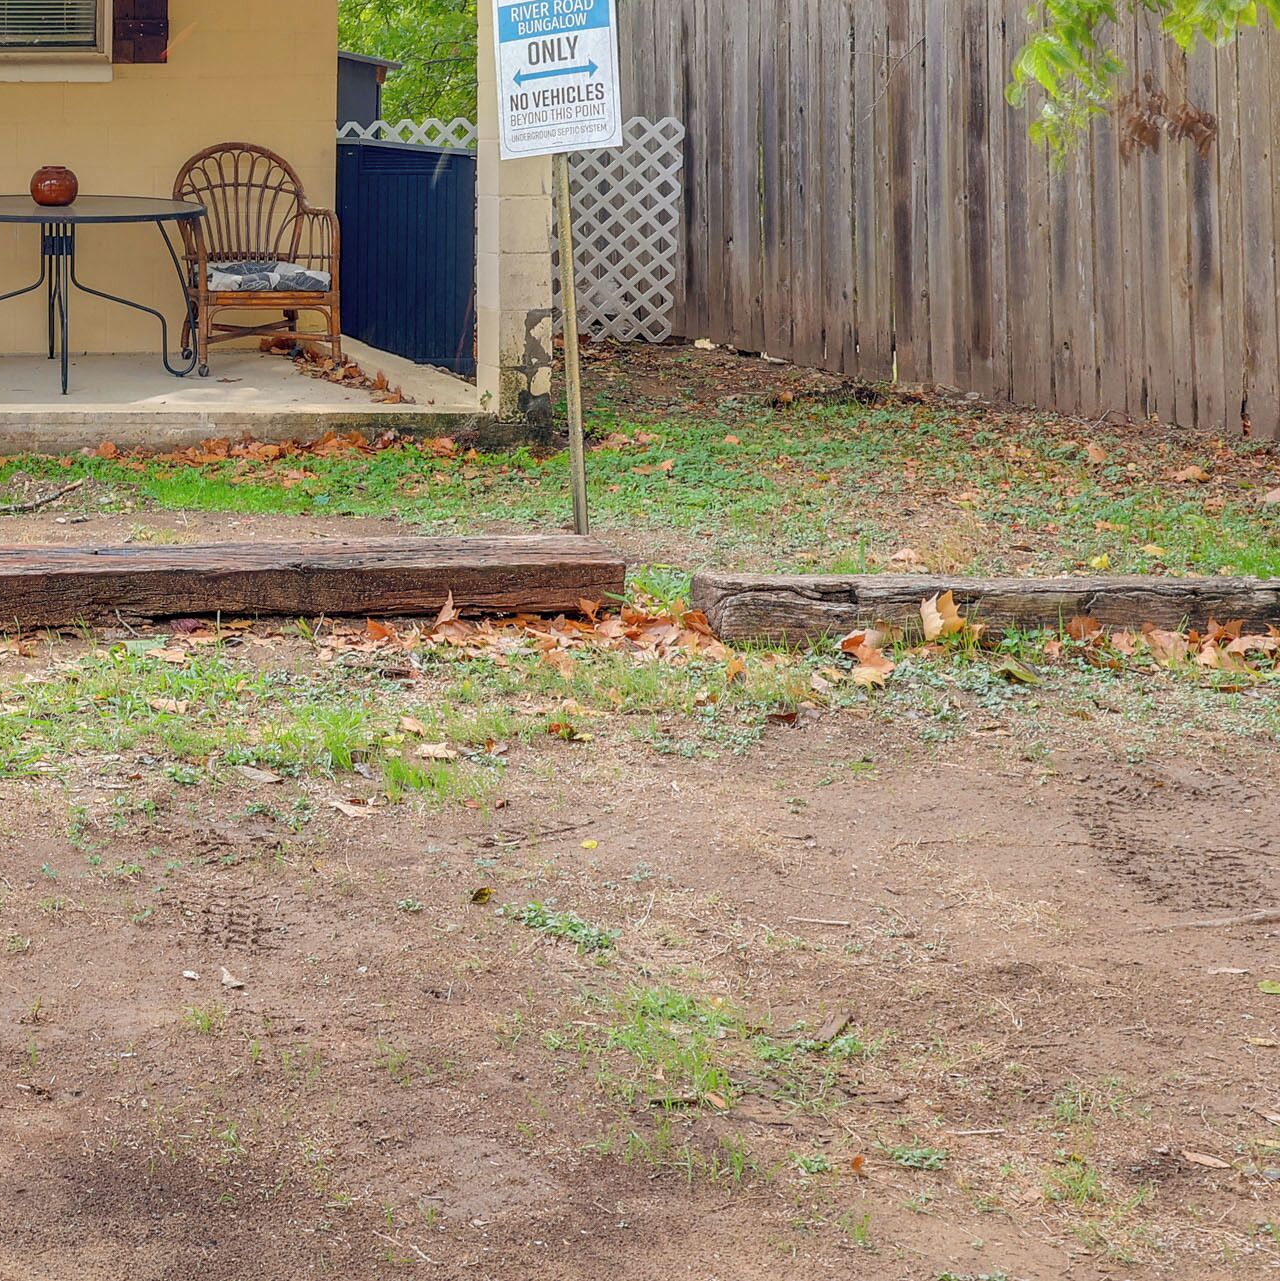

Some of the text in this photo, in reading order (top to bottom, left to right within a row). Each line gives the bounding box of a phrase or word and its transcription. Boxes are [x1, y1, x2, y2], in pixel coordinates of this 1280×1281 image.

[511, 2, 549, 22] RIVER
[519, 13, 587, 35] BUNGALOW
[528, 35, 578, 65] ONLY
[510, 83, 604, 112] NO VEHICLES
[511, 103, 606, 127] BEYOND THIS POINT
[512, 123, 607, 143] UNDERGROUND SEPTIC SYSTEM
